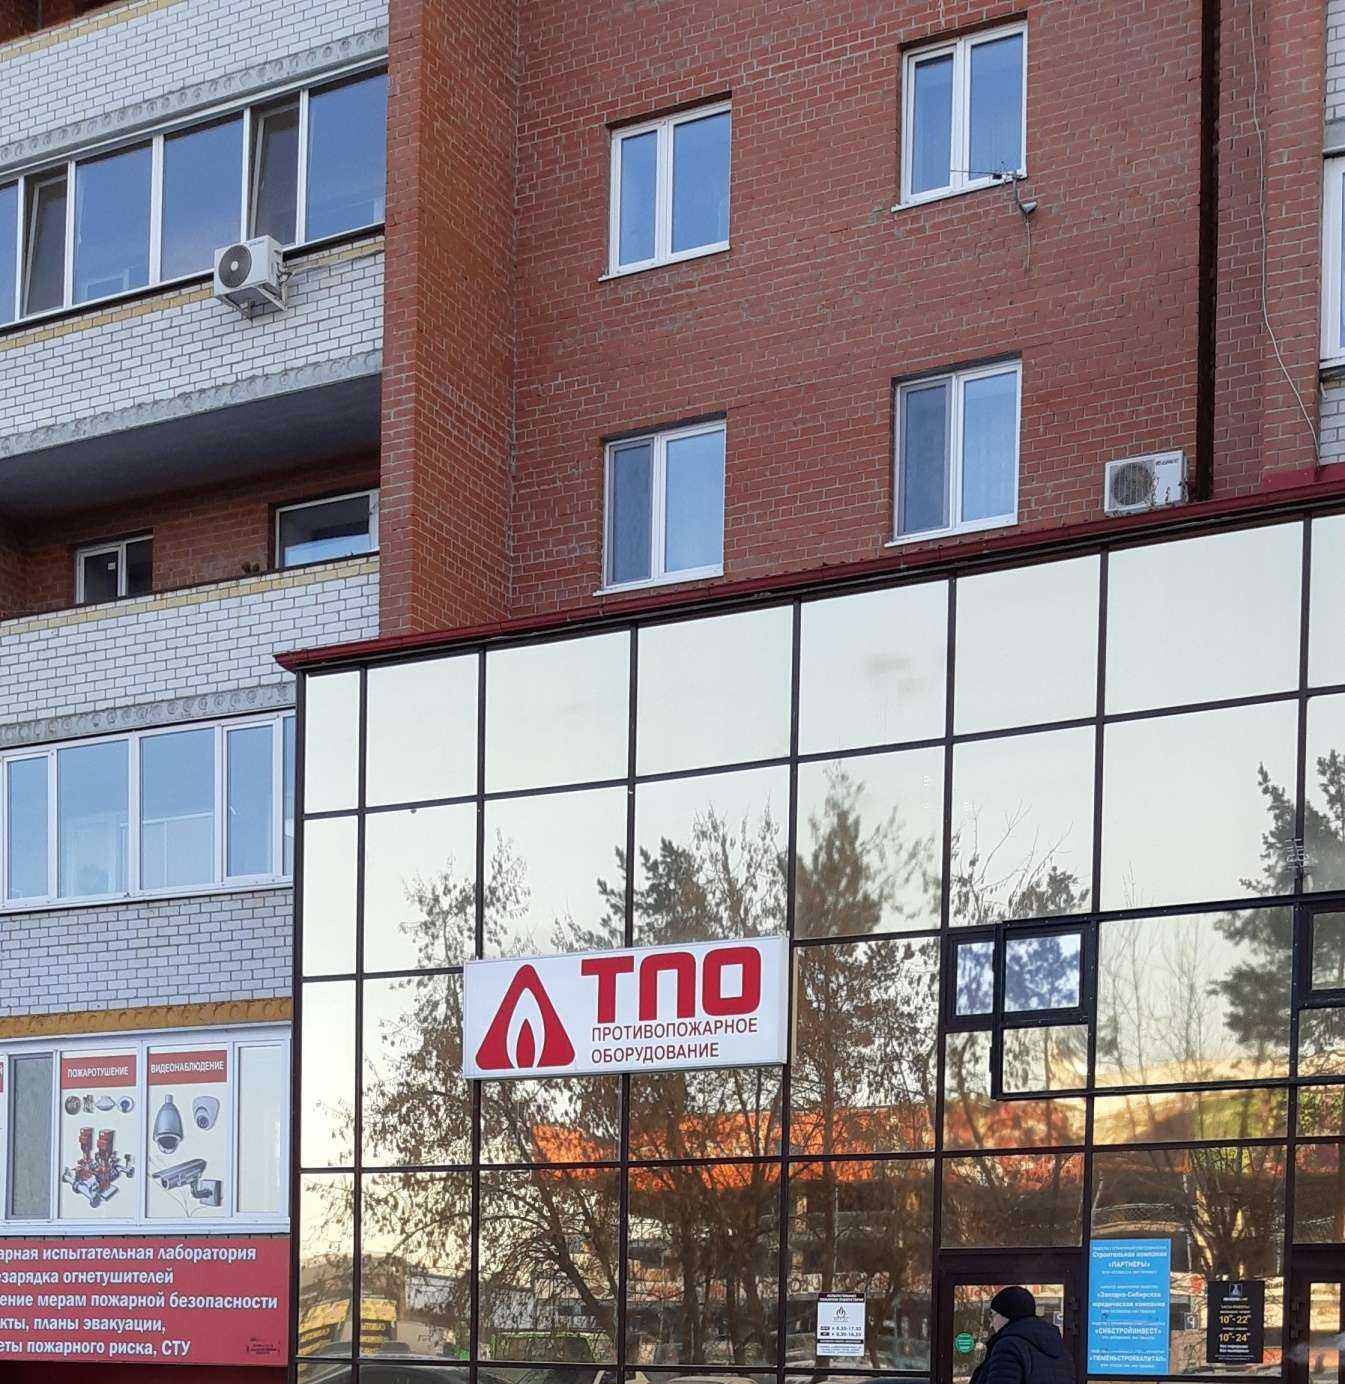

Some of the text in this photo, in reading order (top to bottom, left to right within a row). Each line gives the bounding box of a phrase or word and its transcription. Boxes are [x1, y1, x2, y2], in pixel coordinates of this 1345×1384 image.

[581, 946, 762, 1024] ТПО
[591, 1017, 758, 1042] ПРОТИВОПОЖАРНОЕ
[591, 1042, 720, 1064] ОБОРУДОВАНИЕ
[67, 1065, 129, 1078] ПОЖАРОТУШЕНИЕ
[150, 1060, 225, 1075] ВИДЕОНАБЛЮДЕНИЕ
[43, 1246, 154, 1263] испытательная
[158, 1243, 256, 1263] лаборатория
[0, 1267, 174, 1287] зарядка огнетушителей
[37, 1295, 87, 1310] мерам
[90, 1290, 165, 1310] пожарной
[169, 1292, 278, 1309] безопасности
[34, 1318, 79, 1331] планы
[83, 1317, 166, 1334] эвакуации,
[27, 1340, 105, 1357] пожарного
[109, 1341, 157, 1357] риска,
[161, 1340, 191, 1356] СТУ
